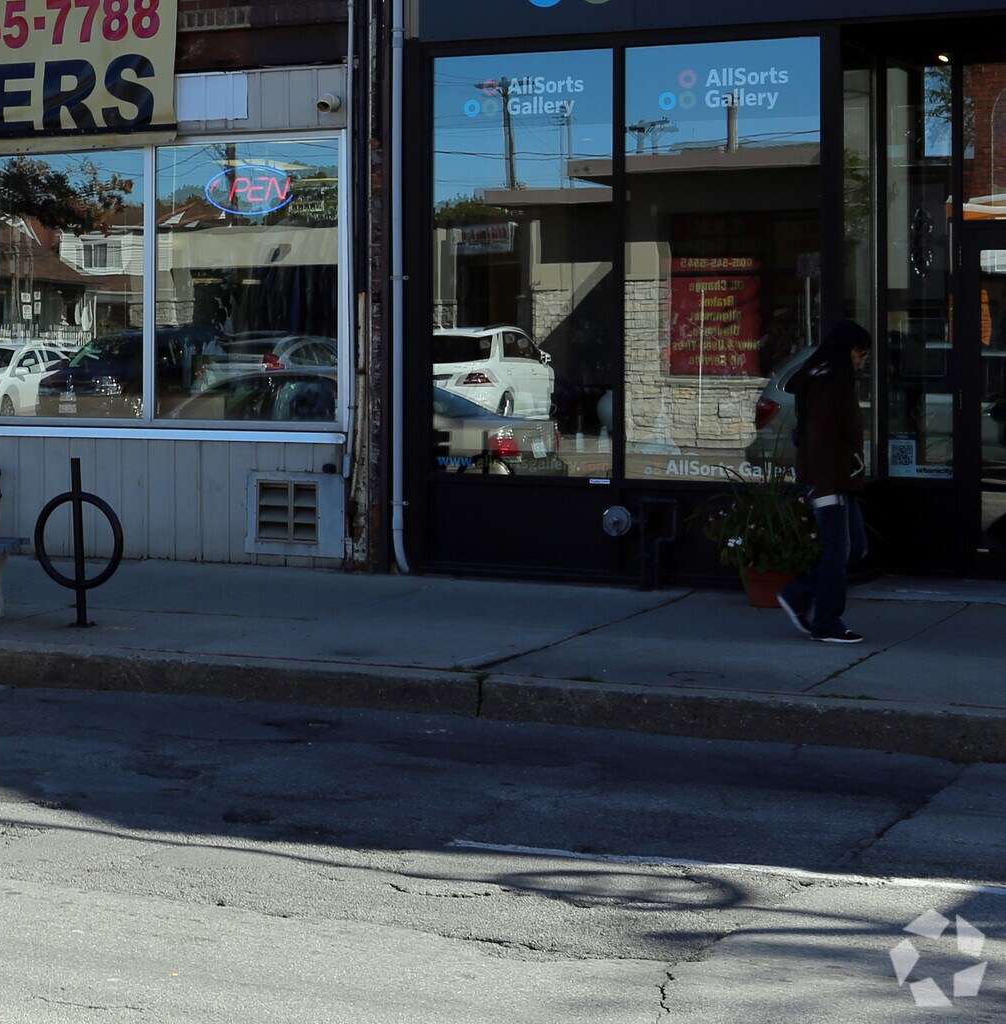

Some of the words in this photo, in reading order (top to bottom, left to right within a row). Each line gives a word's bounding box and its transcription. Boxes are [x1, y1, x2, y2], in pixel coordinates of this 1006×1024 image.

[507, 76, 585, 95] AllSorts
[705, 67, 789, 87] AllSorts
[506, 96, 575, 116] Gallery
[705, 88, 779, 110] Gallery
[210, 176, 292, 202] PEN
[665, 460, 734, 476] AllSorts
